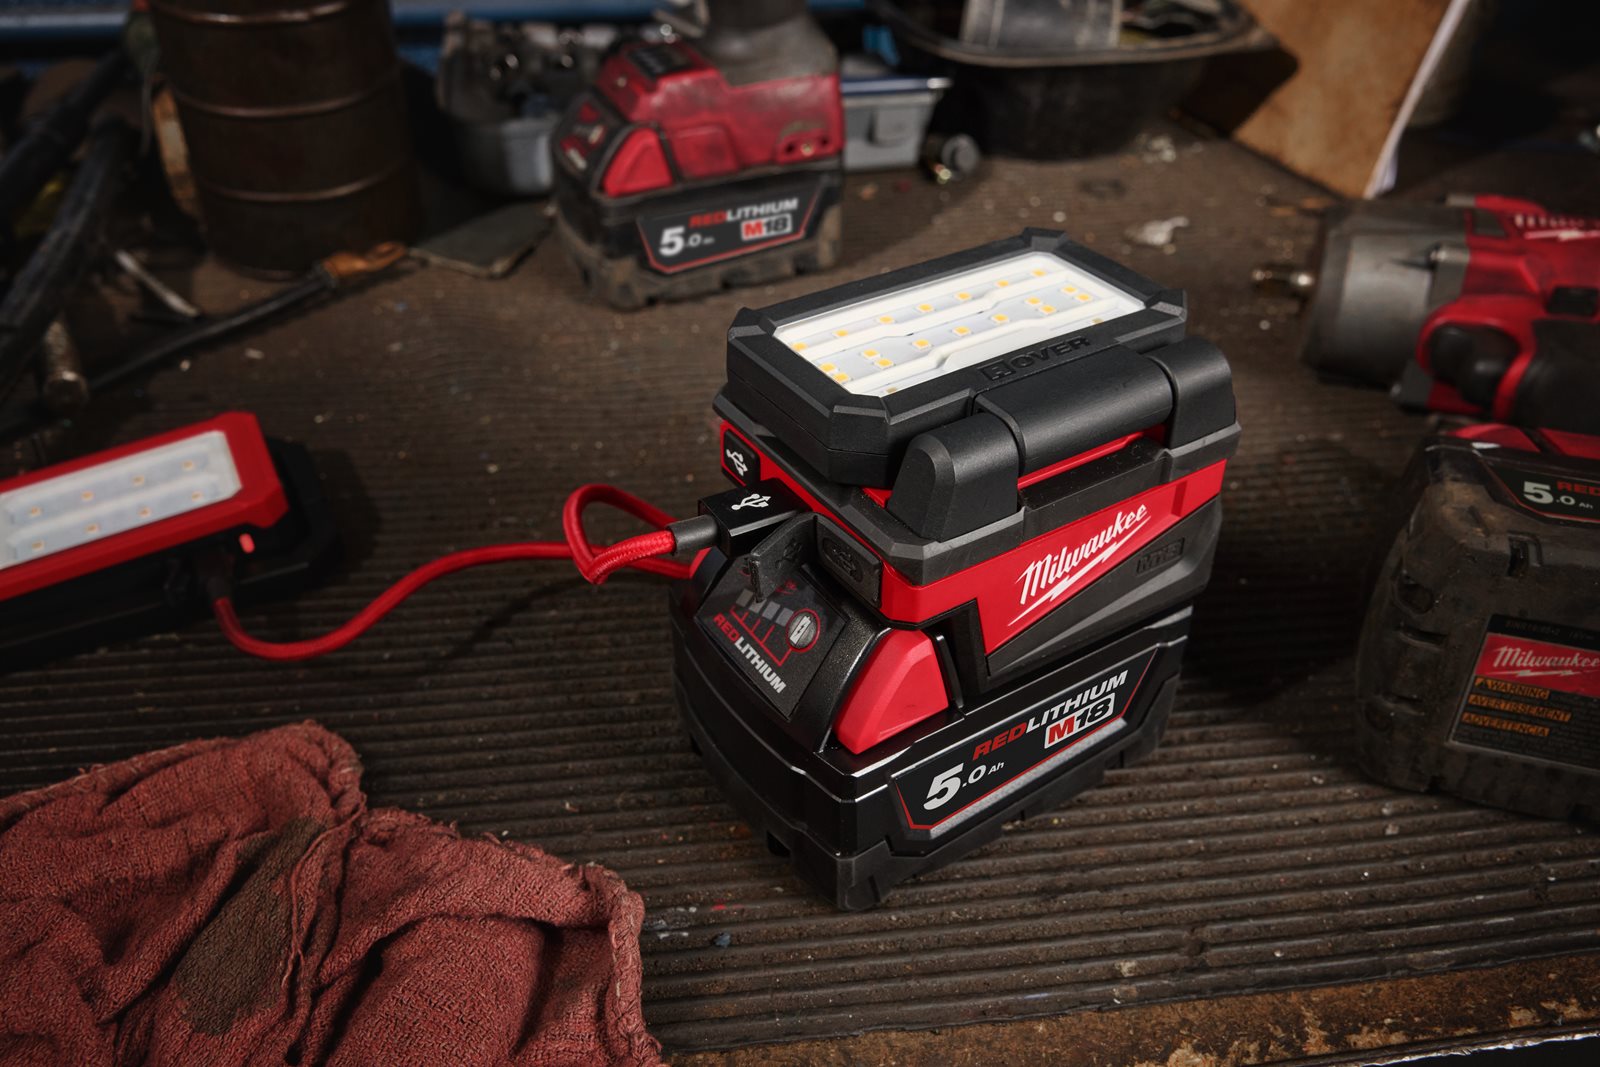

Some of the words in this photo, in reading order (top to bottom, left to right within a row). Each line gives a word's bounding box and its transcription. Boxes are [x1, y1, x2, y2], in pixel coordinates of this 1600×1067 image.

[689, 198, 799, 228] REDLITHIUM
[742, 214, 790, 240] M18
[1523, 481, 1576, 504] 5.0
[1014, 503, 1149, 606] Milwaukee
[713, 612, 787, 694] REDLITHIUM
[1490, 680, 1548, 699] WARNING
[972, 669, 1129, 761] REDLITHIUM
[1046, 697, 1111, 746] M18
[923, 762, 987, 811] 5.0
[987, 761, 1005, 775] Ah
